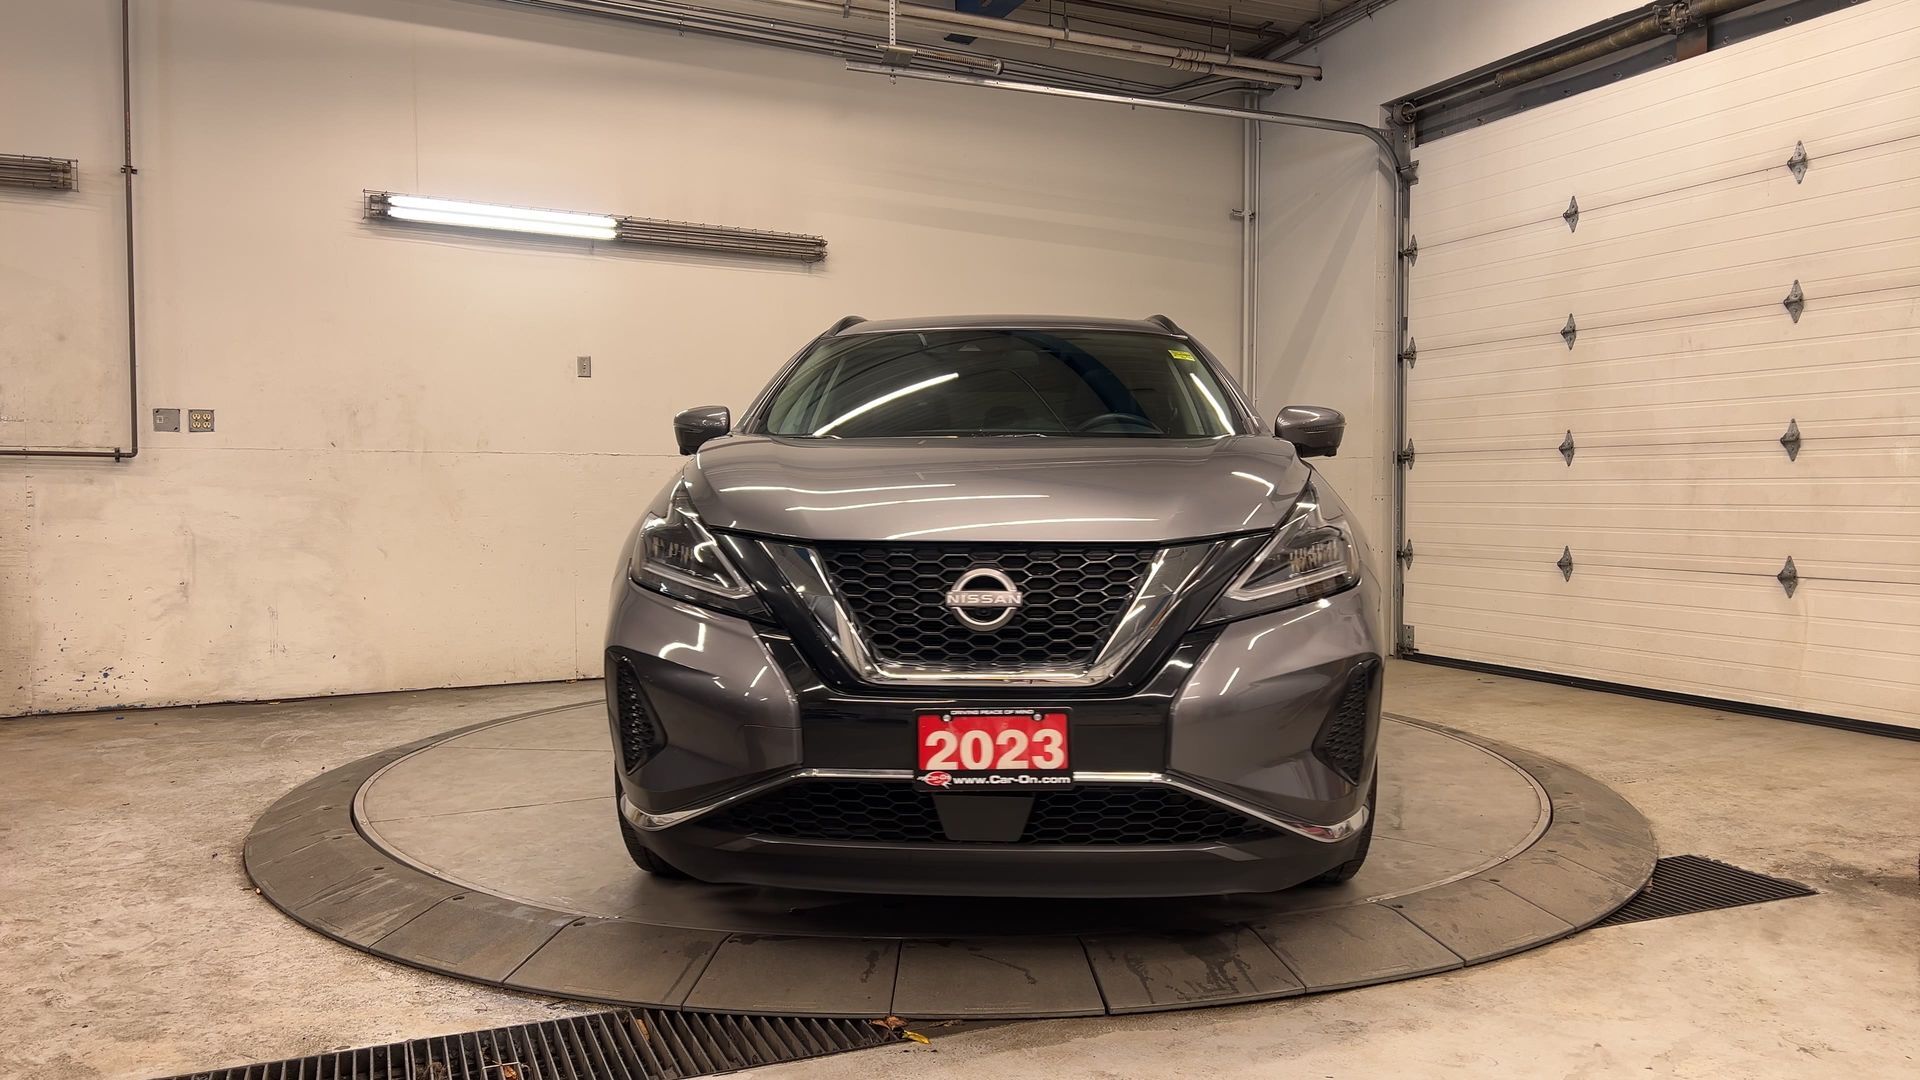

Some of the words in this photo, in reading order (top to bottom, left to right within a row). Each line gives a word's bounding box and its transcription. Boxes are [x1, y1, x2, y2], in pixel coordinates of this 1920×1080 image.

[946, 594, 1022, 604] NISSAN
[925, 728, 1065, 770] 2023
[952, 774, 1071, 784] www.Car-On.com
